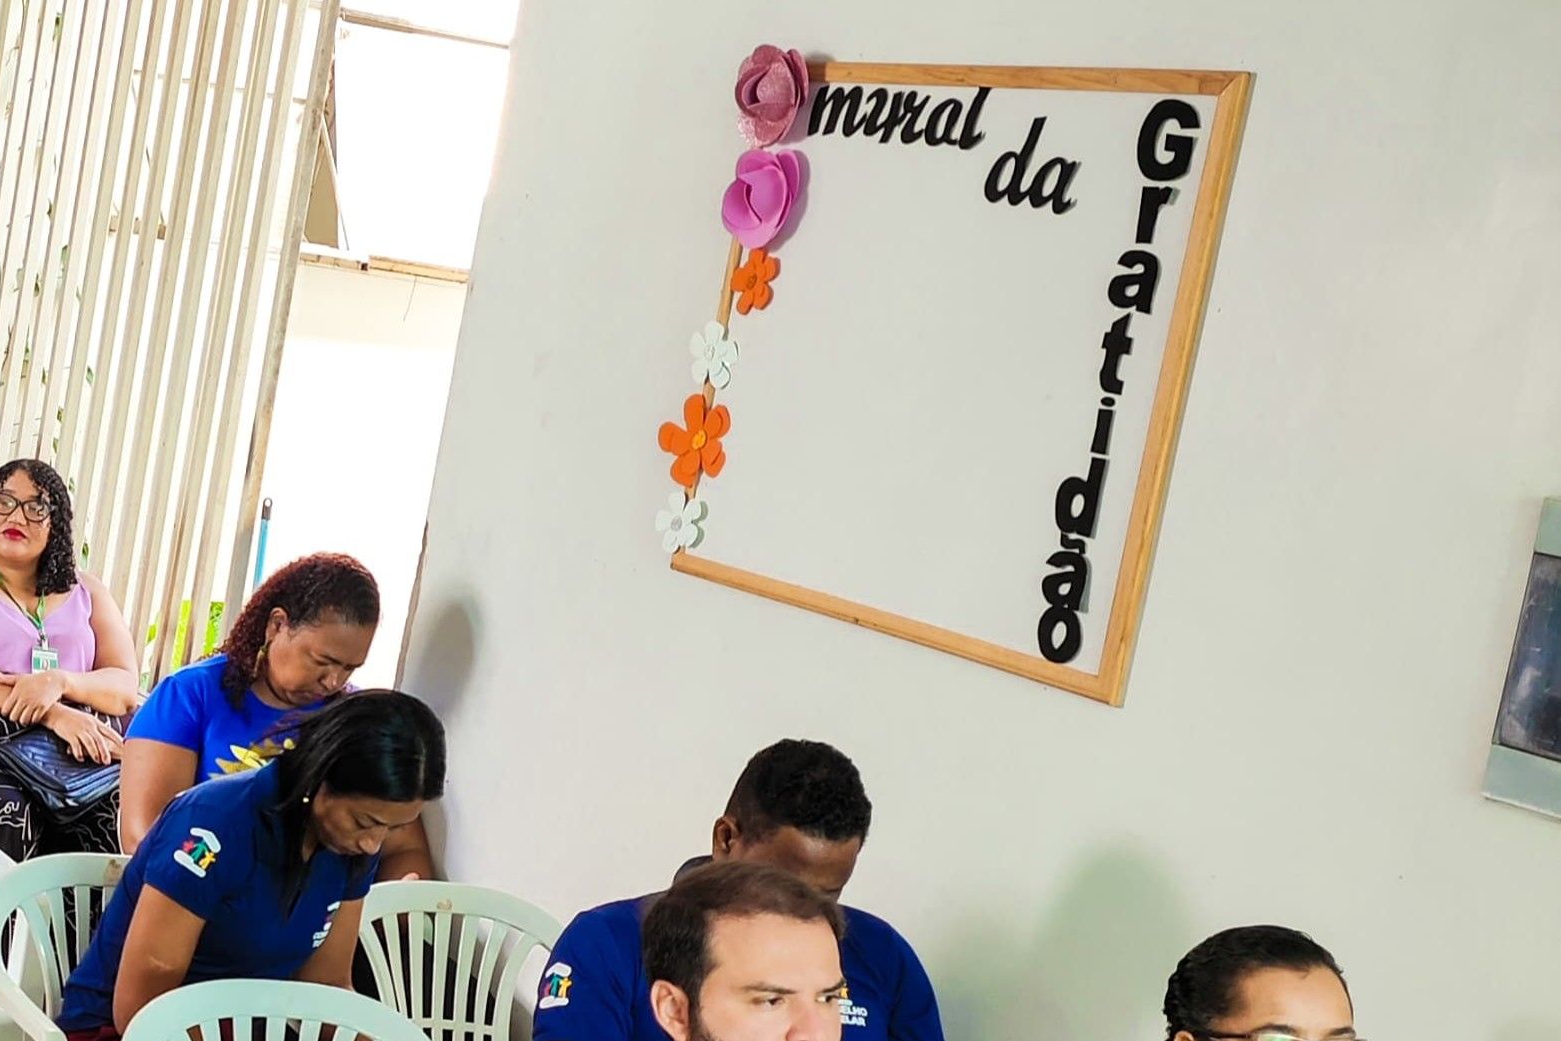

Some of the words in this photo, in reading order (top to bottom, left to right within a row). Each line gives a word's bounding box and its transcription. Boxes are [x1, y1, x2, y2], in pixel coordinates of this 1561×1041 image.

[807, 85, 993, 150] mural
[984, 116, 1079, 215] da
[1037, 98, 1201, 664] Gratidão
